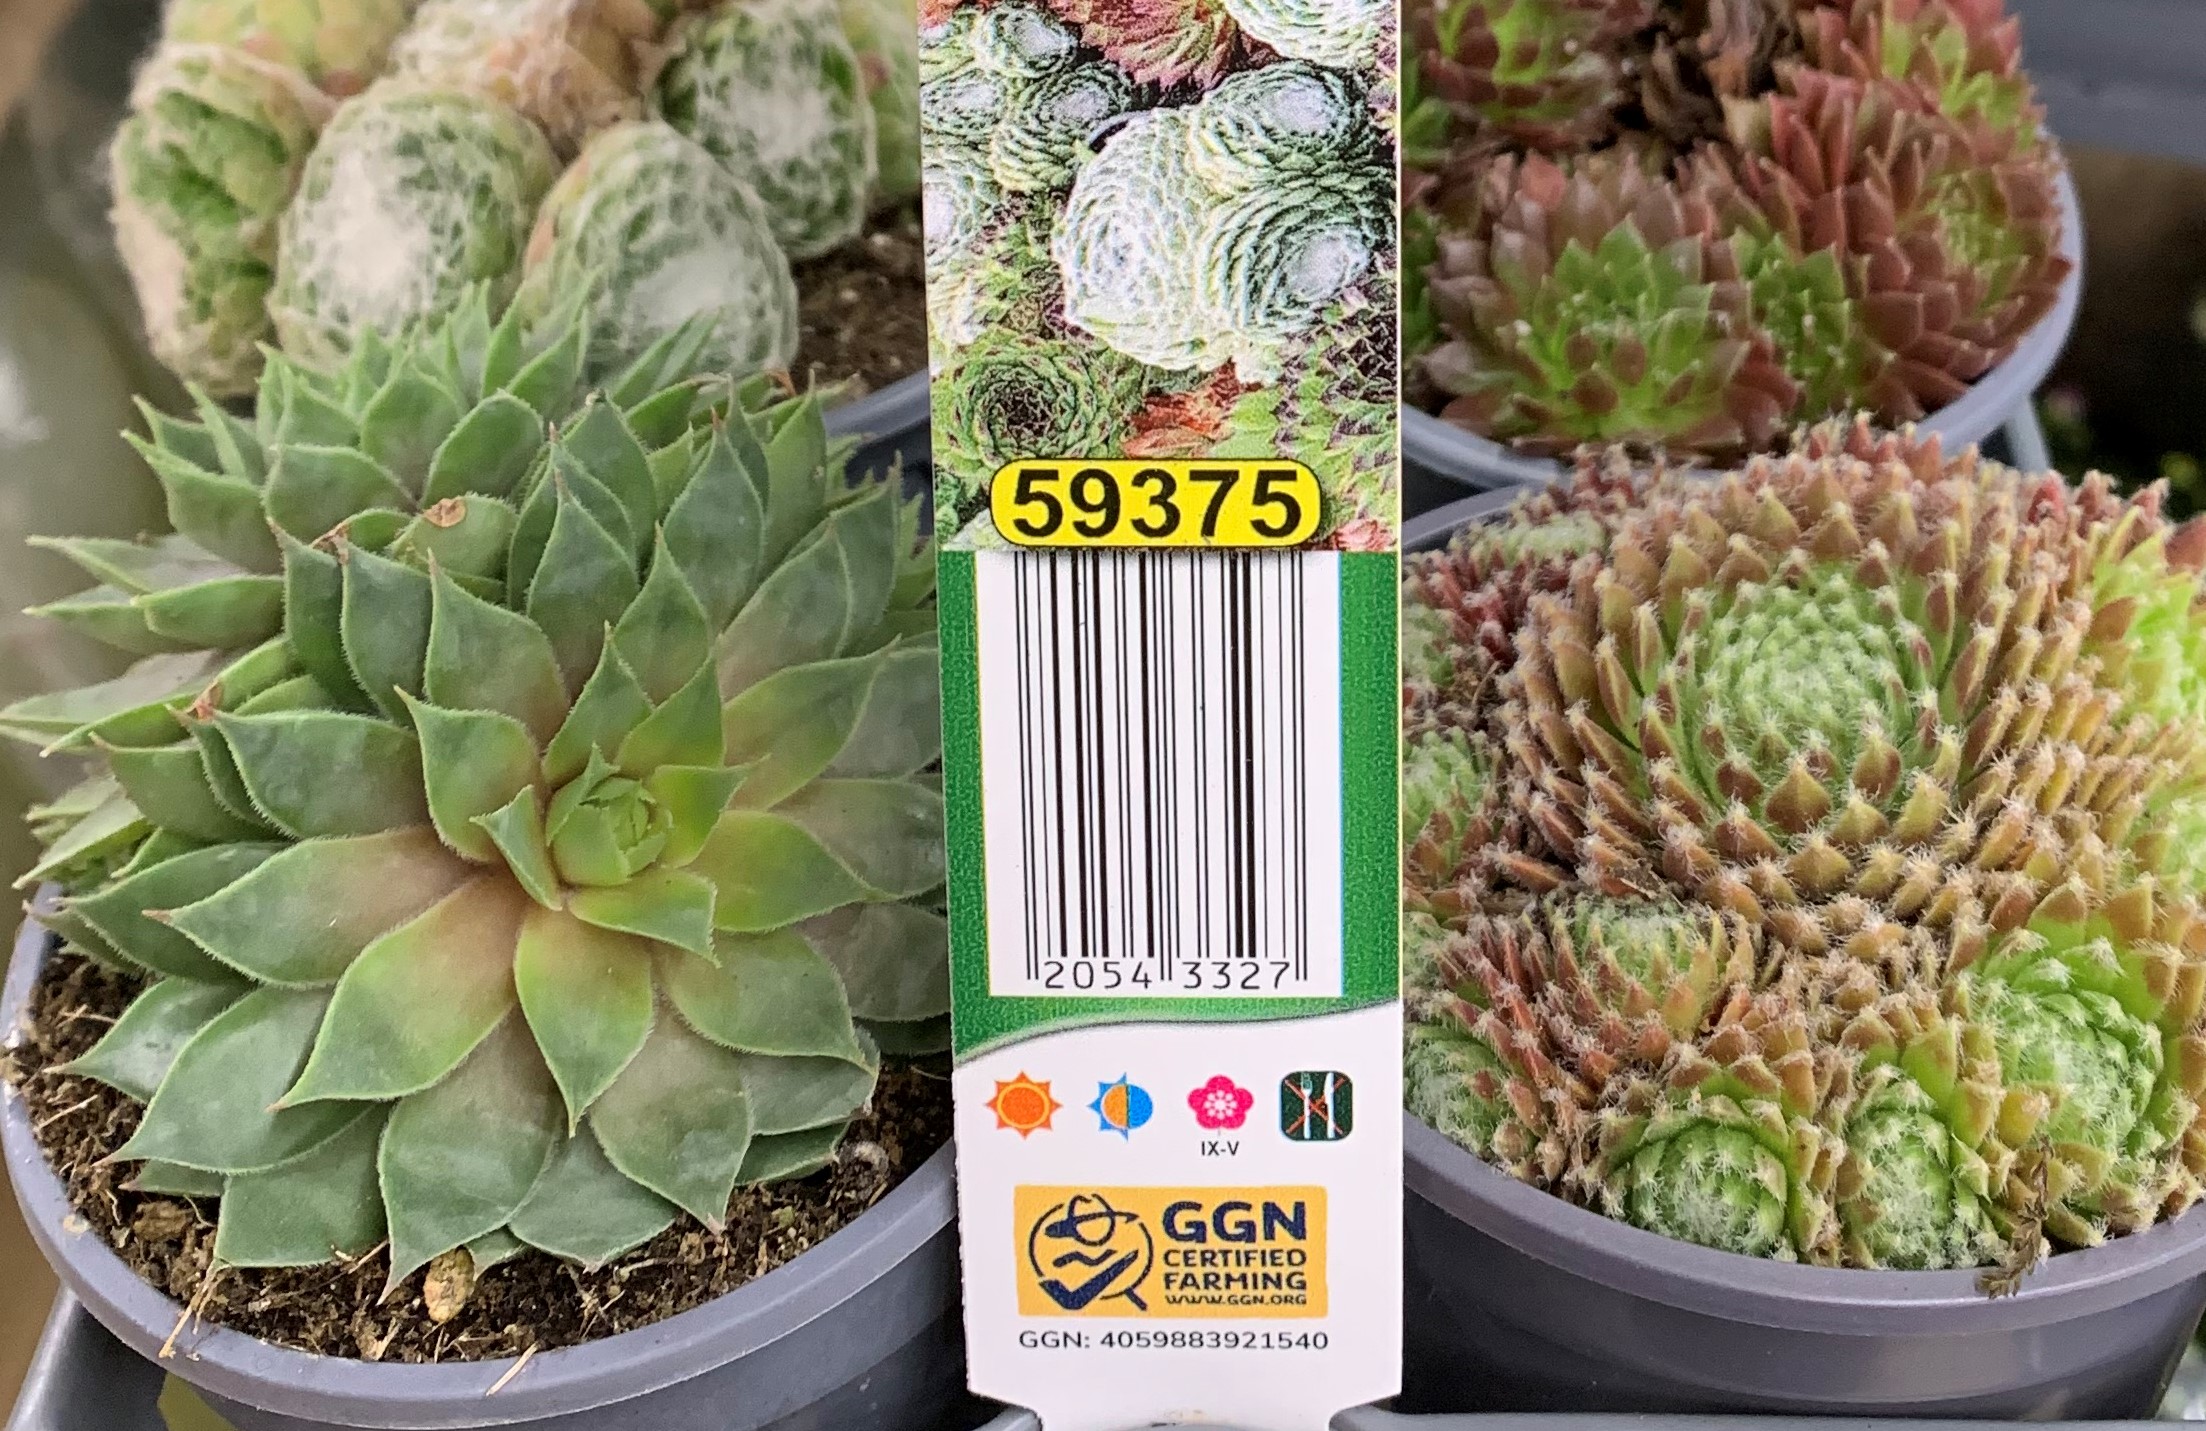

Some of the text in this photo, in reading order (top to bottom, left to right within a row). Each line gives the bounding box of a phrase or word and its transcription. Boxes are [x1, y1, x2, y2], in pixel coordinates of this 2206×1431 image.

[1012, 467, 1302, 538] 59375
[1044, 960, 1291, 989] 2054 3327
[1200, 1141, 1240, 1157] IX-V
[1161, 1200, 1307, 1244] GGN
[1162, 1248, 1307, 1268] CERTIFIED
[1162, 1271, 1307, 1291] FARMING
[1164, 1294, 1307, 1306] WWW.GGN.ORG
[1018, 1330, 1329, 1350] GGN: 4059883921540
